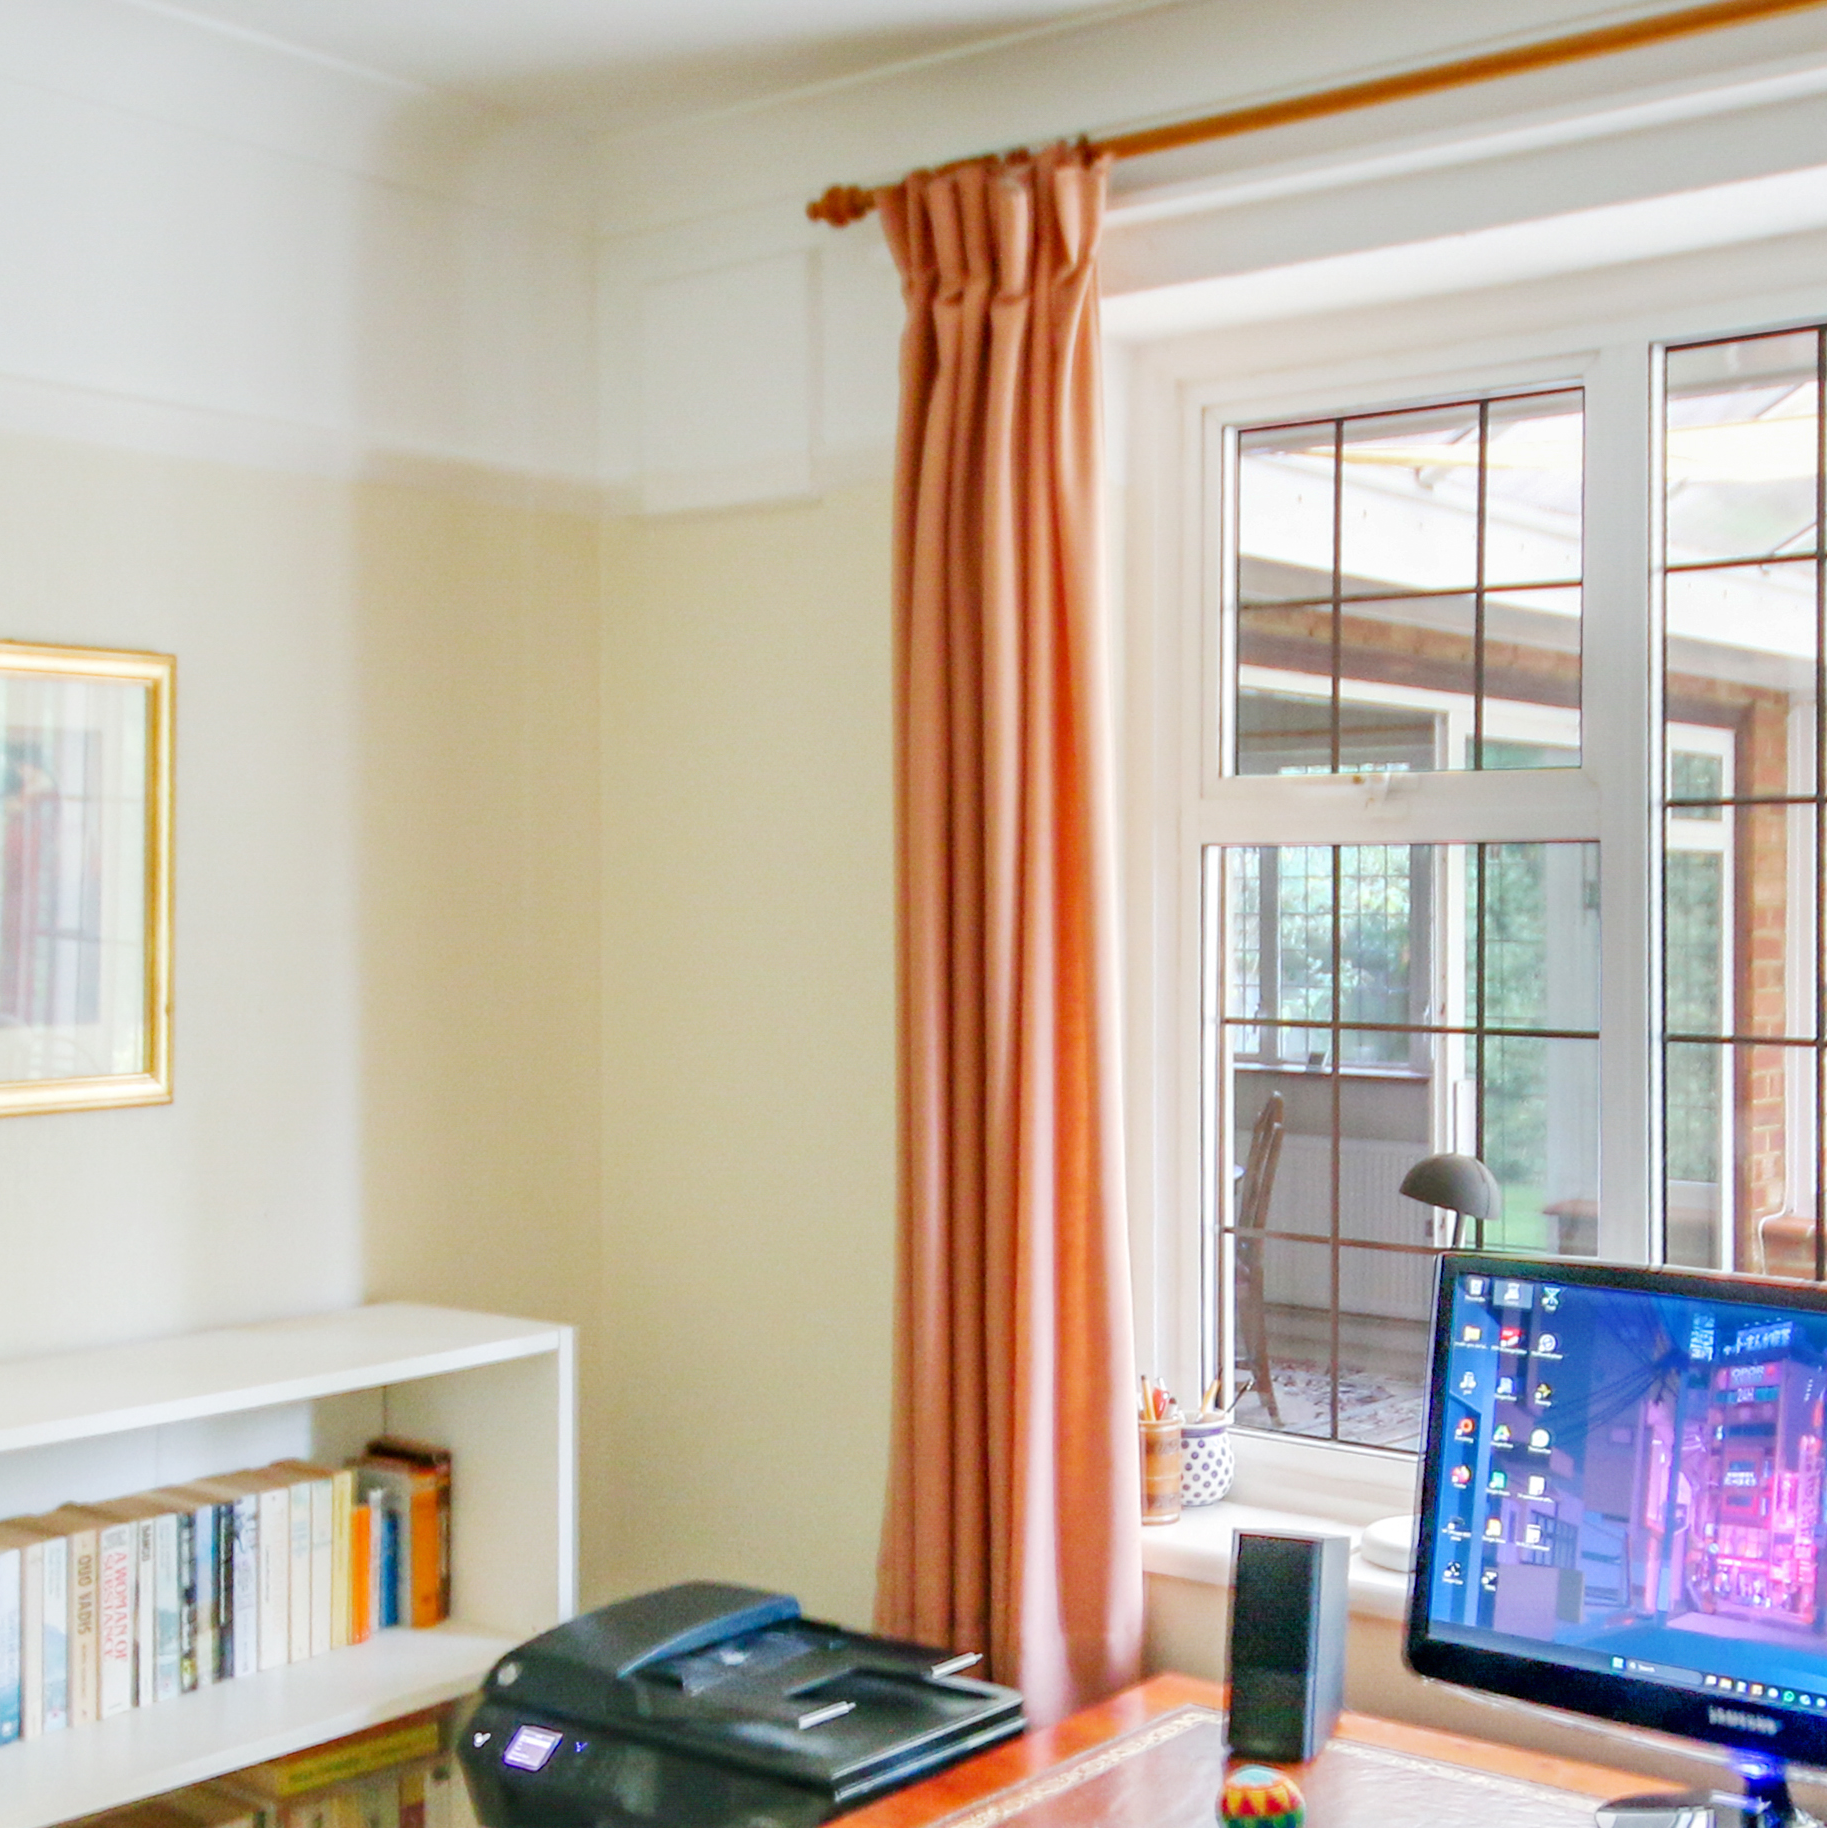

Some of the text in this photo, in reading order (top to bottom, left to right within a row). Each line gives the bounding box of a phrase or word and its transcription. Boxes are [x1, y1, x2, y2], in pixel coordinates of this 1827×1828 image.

[77, 1554, 93, 1588] QUO
[103, 1552, 116, 1659] SUBSTANCE
[114, 1552, 129, 1660] A WOMAN OF
[77, 1591, 93, 1636] VADIS
